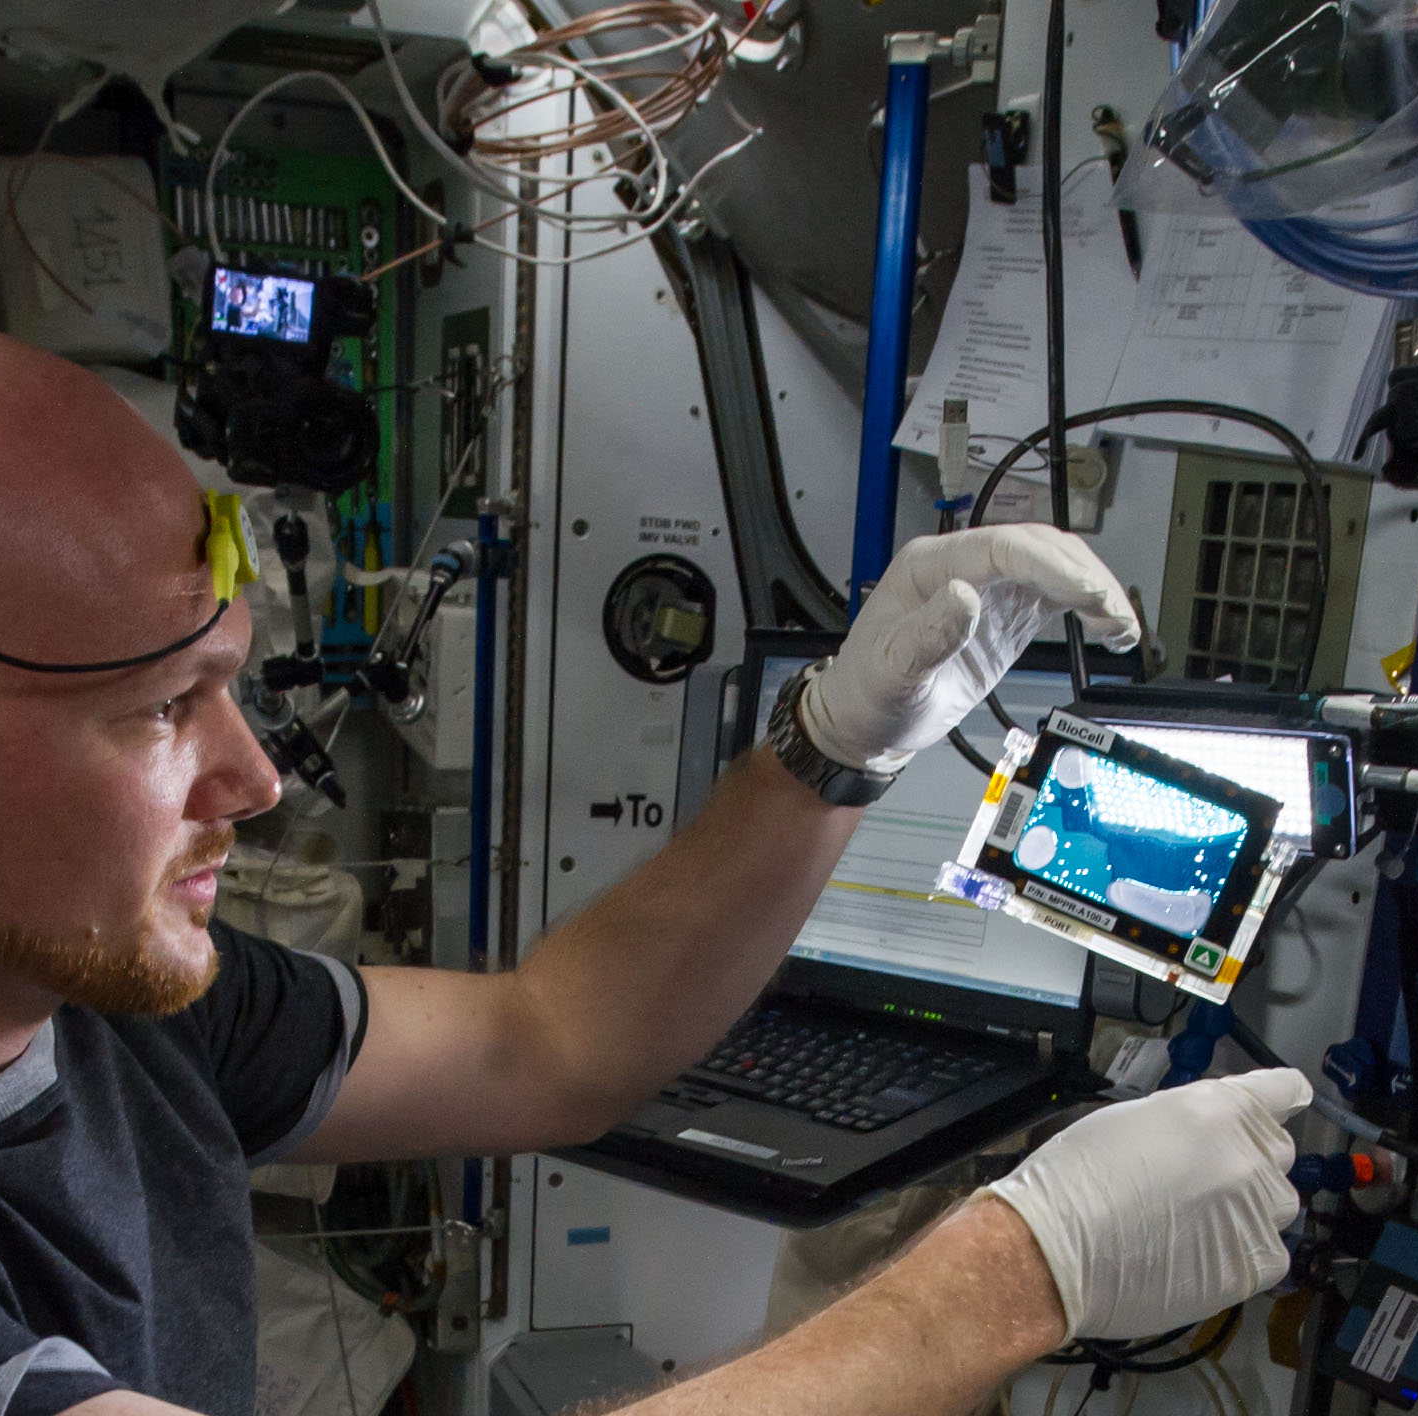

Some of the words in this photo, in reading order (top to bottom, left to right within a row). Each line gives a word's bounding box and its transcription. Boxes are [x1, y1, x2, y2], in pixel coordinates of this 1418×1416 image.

[1057, 720, 1105, 746] BioCell
[626, 794, 663, 828] To
[1027, 884, 1046, 898] P/N:
[1048, 893, 1111, 926] MPPR-A100-2
[1043, 915, 1071, 932] PORT
